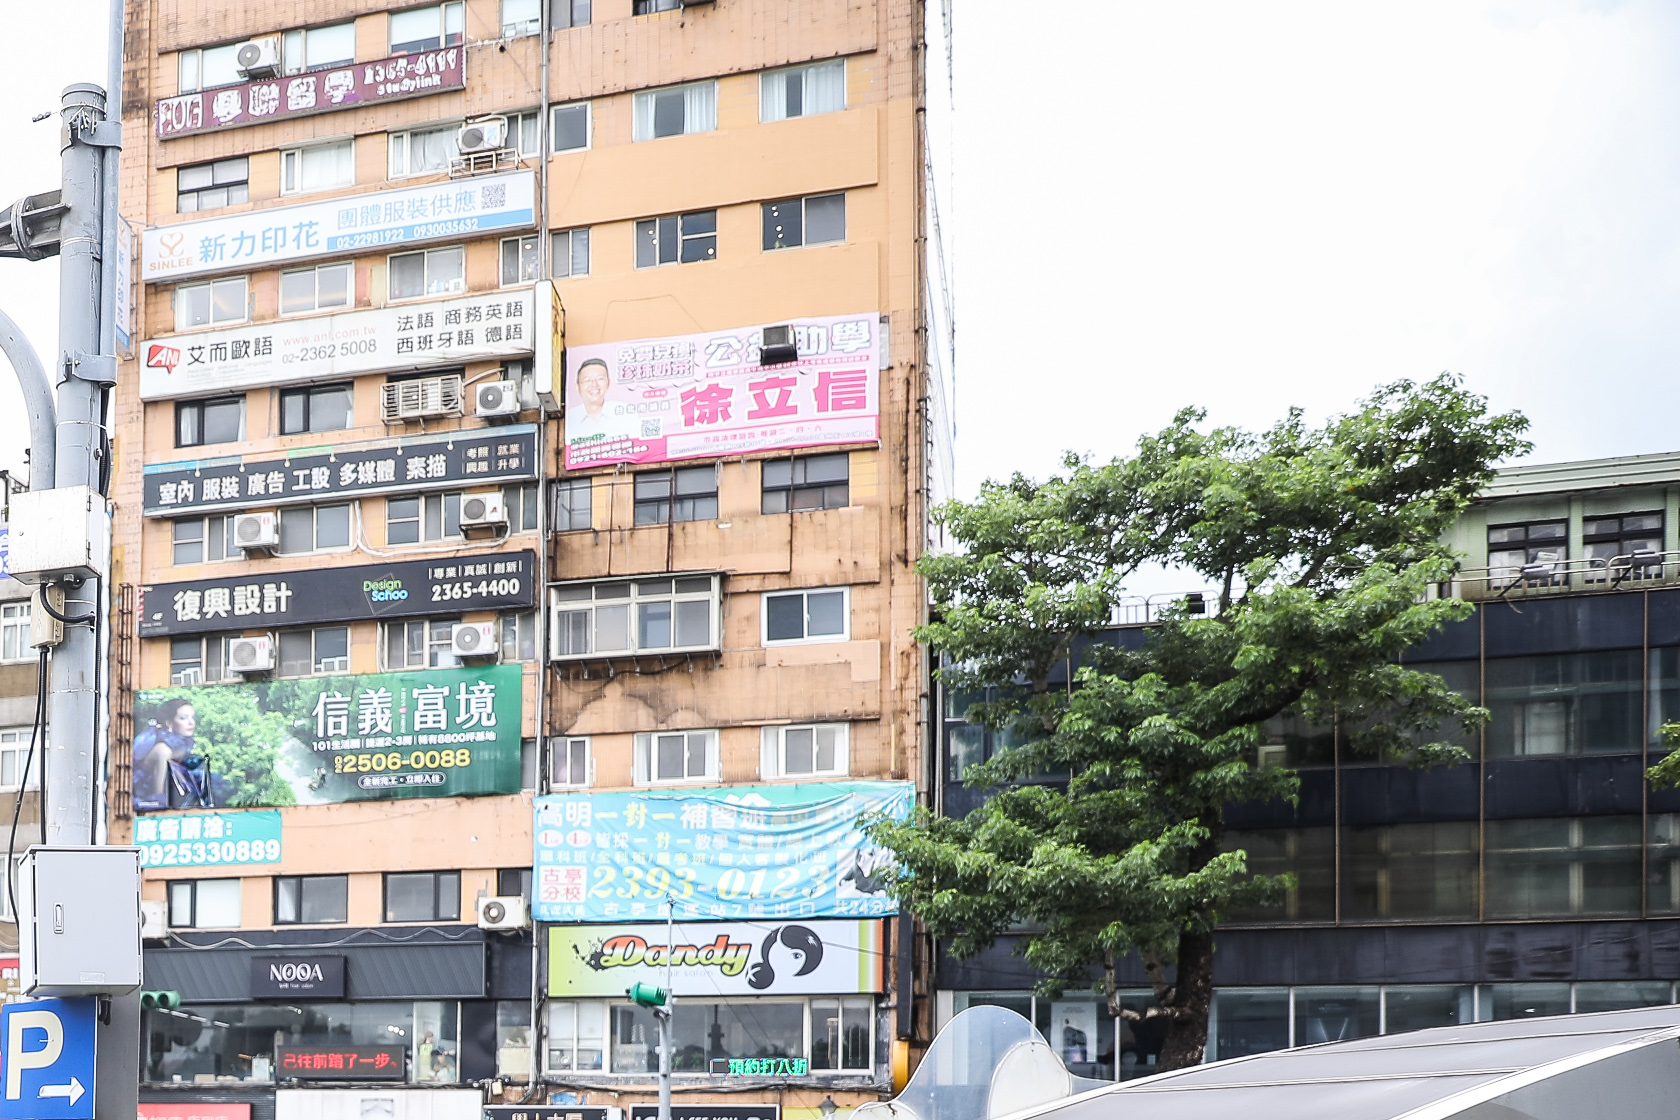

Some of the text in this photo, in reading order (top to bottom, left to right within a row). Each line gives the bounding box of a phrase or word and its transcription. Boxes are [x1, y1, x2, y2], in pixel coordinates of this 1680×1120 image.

[337, 189, 477, 230] 團體服裝供應
[199, 221, 320, 263] 新力印花
[336, 218, 479, 249] 02-22981922 0930035632
[149, 256, 193, 272] SINLEE
[397, 300, 524, 332] 法語 商務英語
[187, 335, 273, 366] 艾而歐語
[282, 339, 377, 365] 02-2362 5008
[396, 323, 524, 355] 西班牙語 德語
[679, 368, 868, 428] 徐立信
[158, 453, 447, 505] 室內 服裝 廣告 工設 多媒體 素描
[173, 581, 293, 622] 復興設計
[431, 577, 521, 602] 2365-4400
[311, 687, 393, 739] 信義
[412, 680, 498, 731] 富境
[343, 748, 471, 774] 2506-0088
[138, 838, 281, 866] 0925330889
[544, 868, 581, 882] 古亭
[588, 865, 830, 901] 2393-0123
[543, 886, 581, 901] 分校
[601, 934, 752, 977] Dandy
[270, 963, 324, 982] NOOA
[5, 1010, 64, 1100] P
[728, 1058, 808, 1077] 預約打八折
